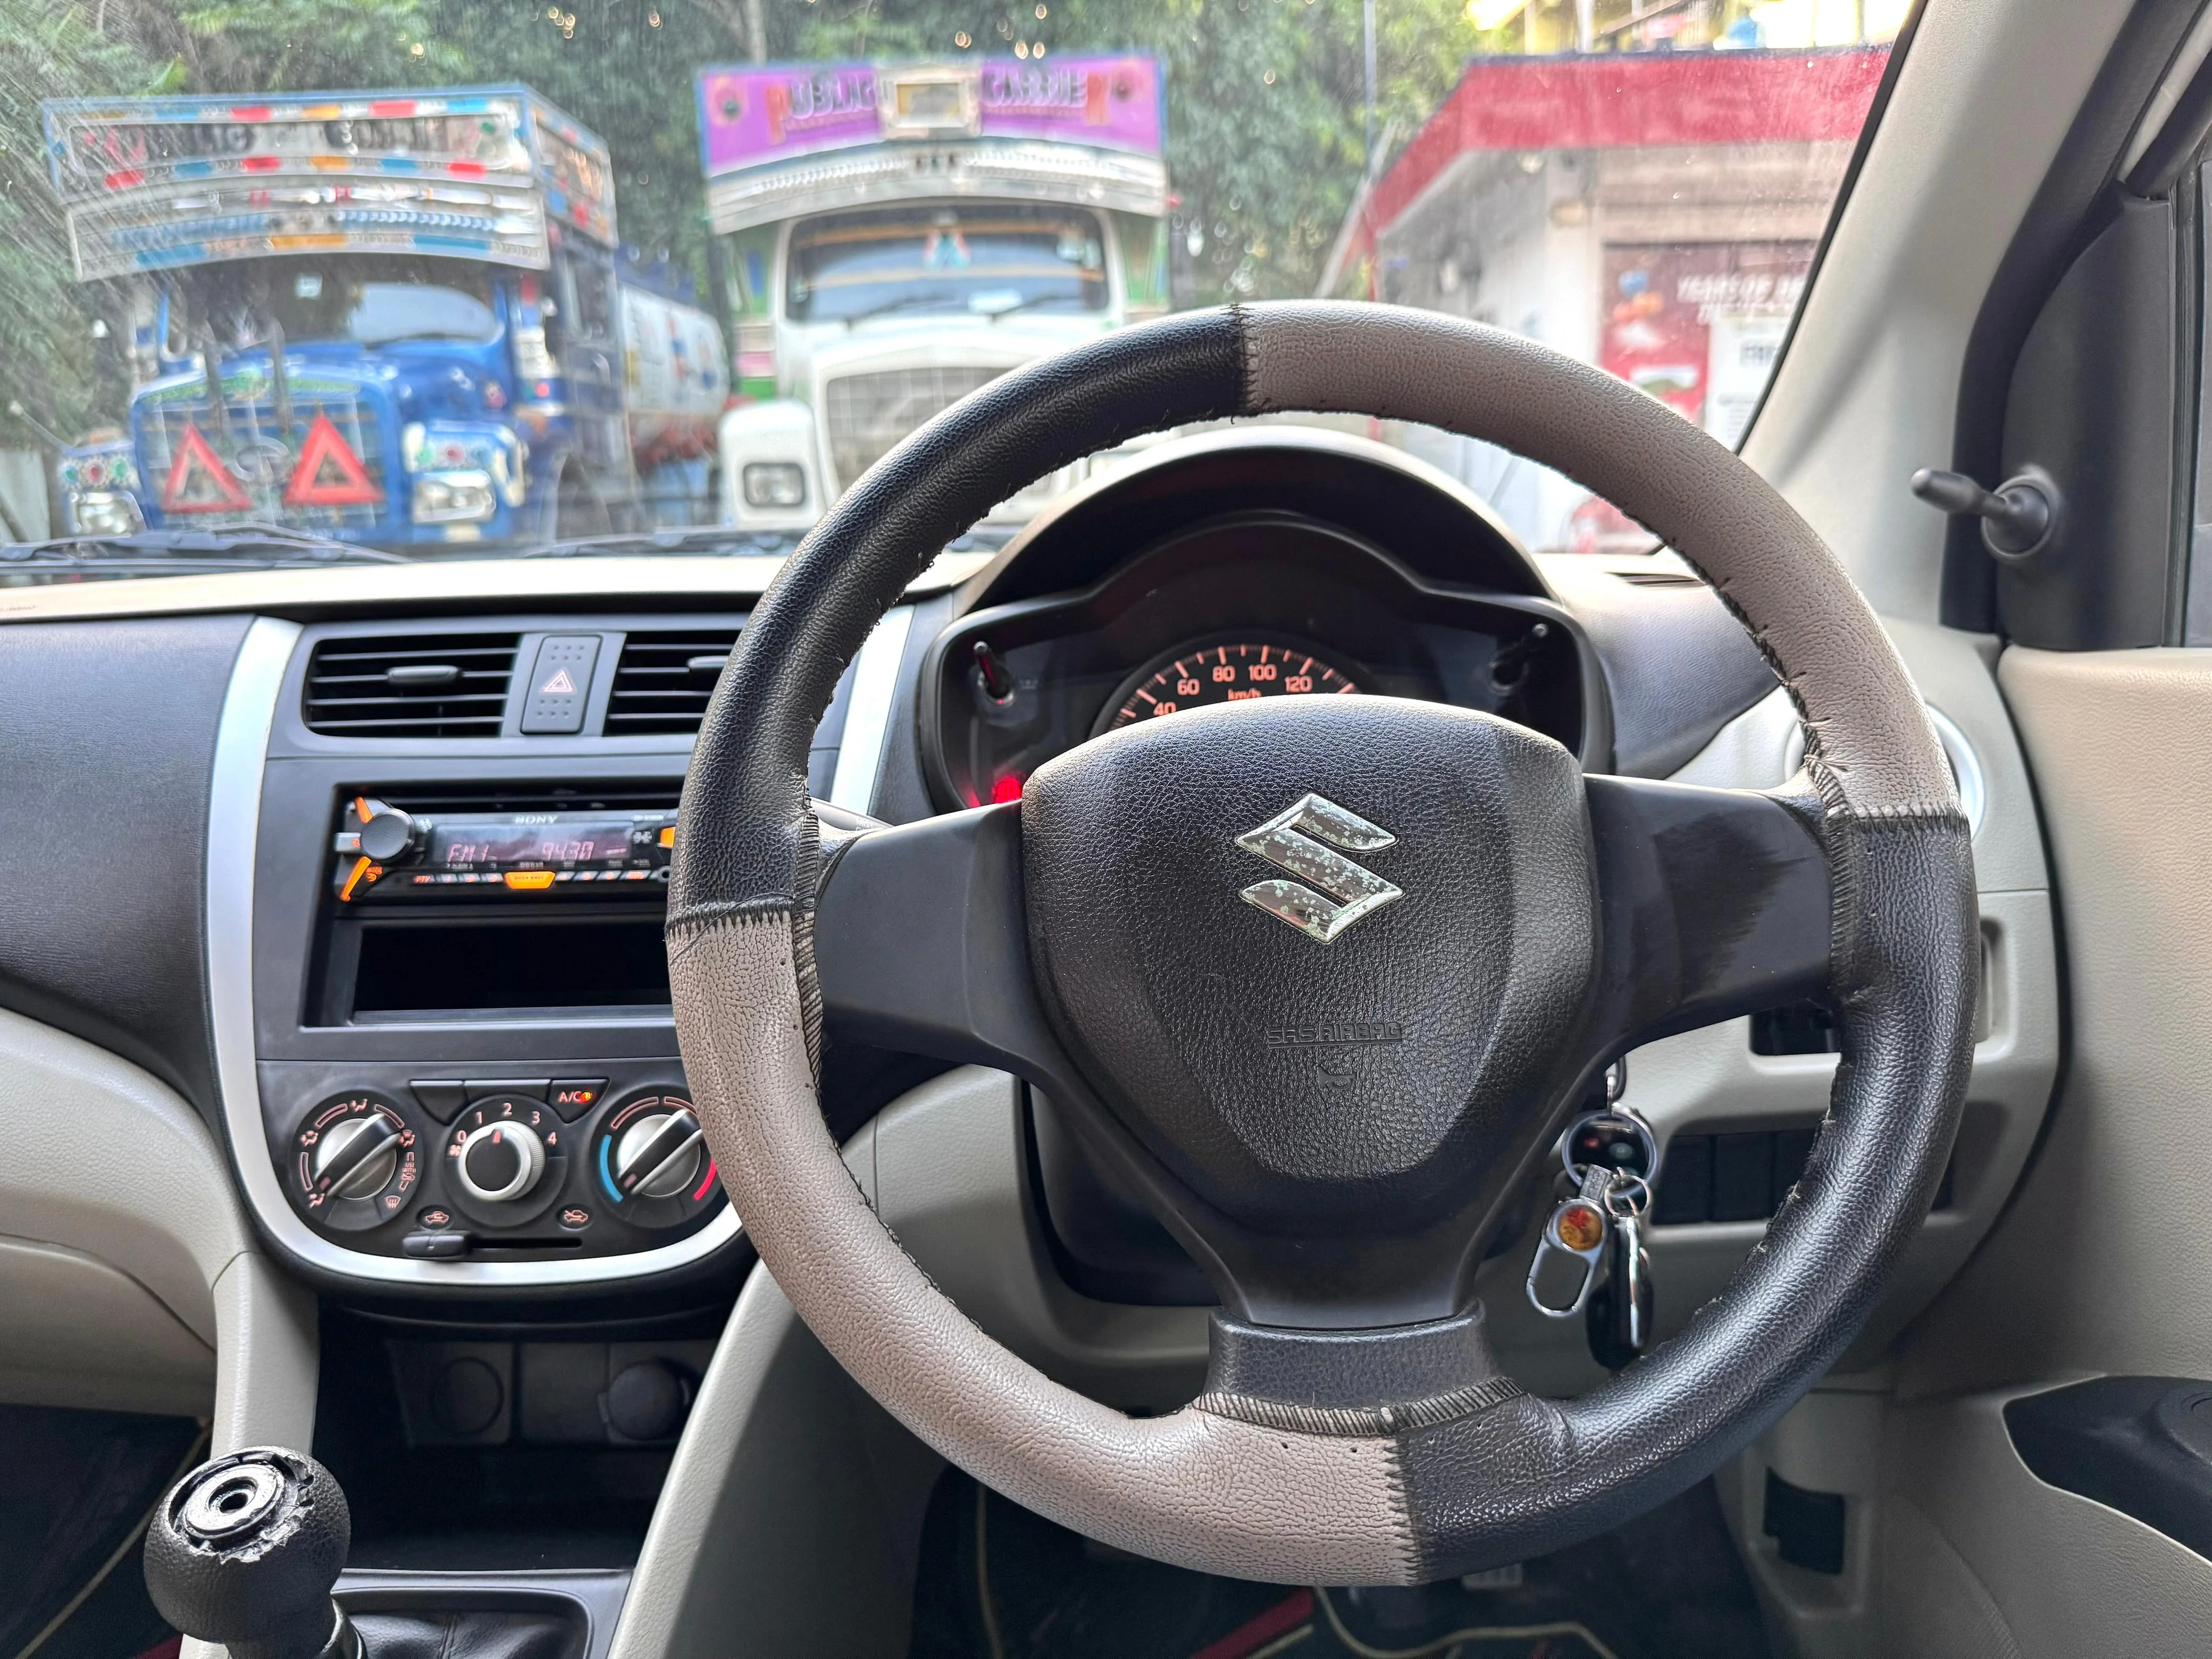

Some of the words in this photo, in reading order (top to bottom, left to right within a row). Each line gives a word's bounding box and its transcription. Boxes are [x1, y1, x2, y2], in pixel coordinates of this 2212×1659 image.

[1212, 665, 1235, 682] 80
[1249, 664, 1276, 681] 100
[1177, 678, 1200, 695] 60
[1285, 675, 1312, 692] 120
[1227, 688, 1261, 701] km/h
[1153, 701, 1176, 716] 40
[515, 815, 558, 825] SONY
[1319, 1021, 1402, 1041] AIRBAG
[558, 1091, 581, 1102] A/C
[502, 1103, 512, 1116] 2
[476, 1111, 483, 1125] 1
[532, 1111, 540, 1125] 3
[457, 1130, 467, 1143] 0
[548, 1132, 557, 1145] 4
